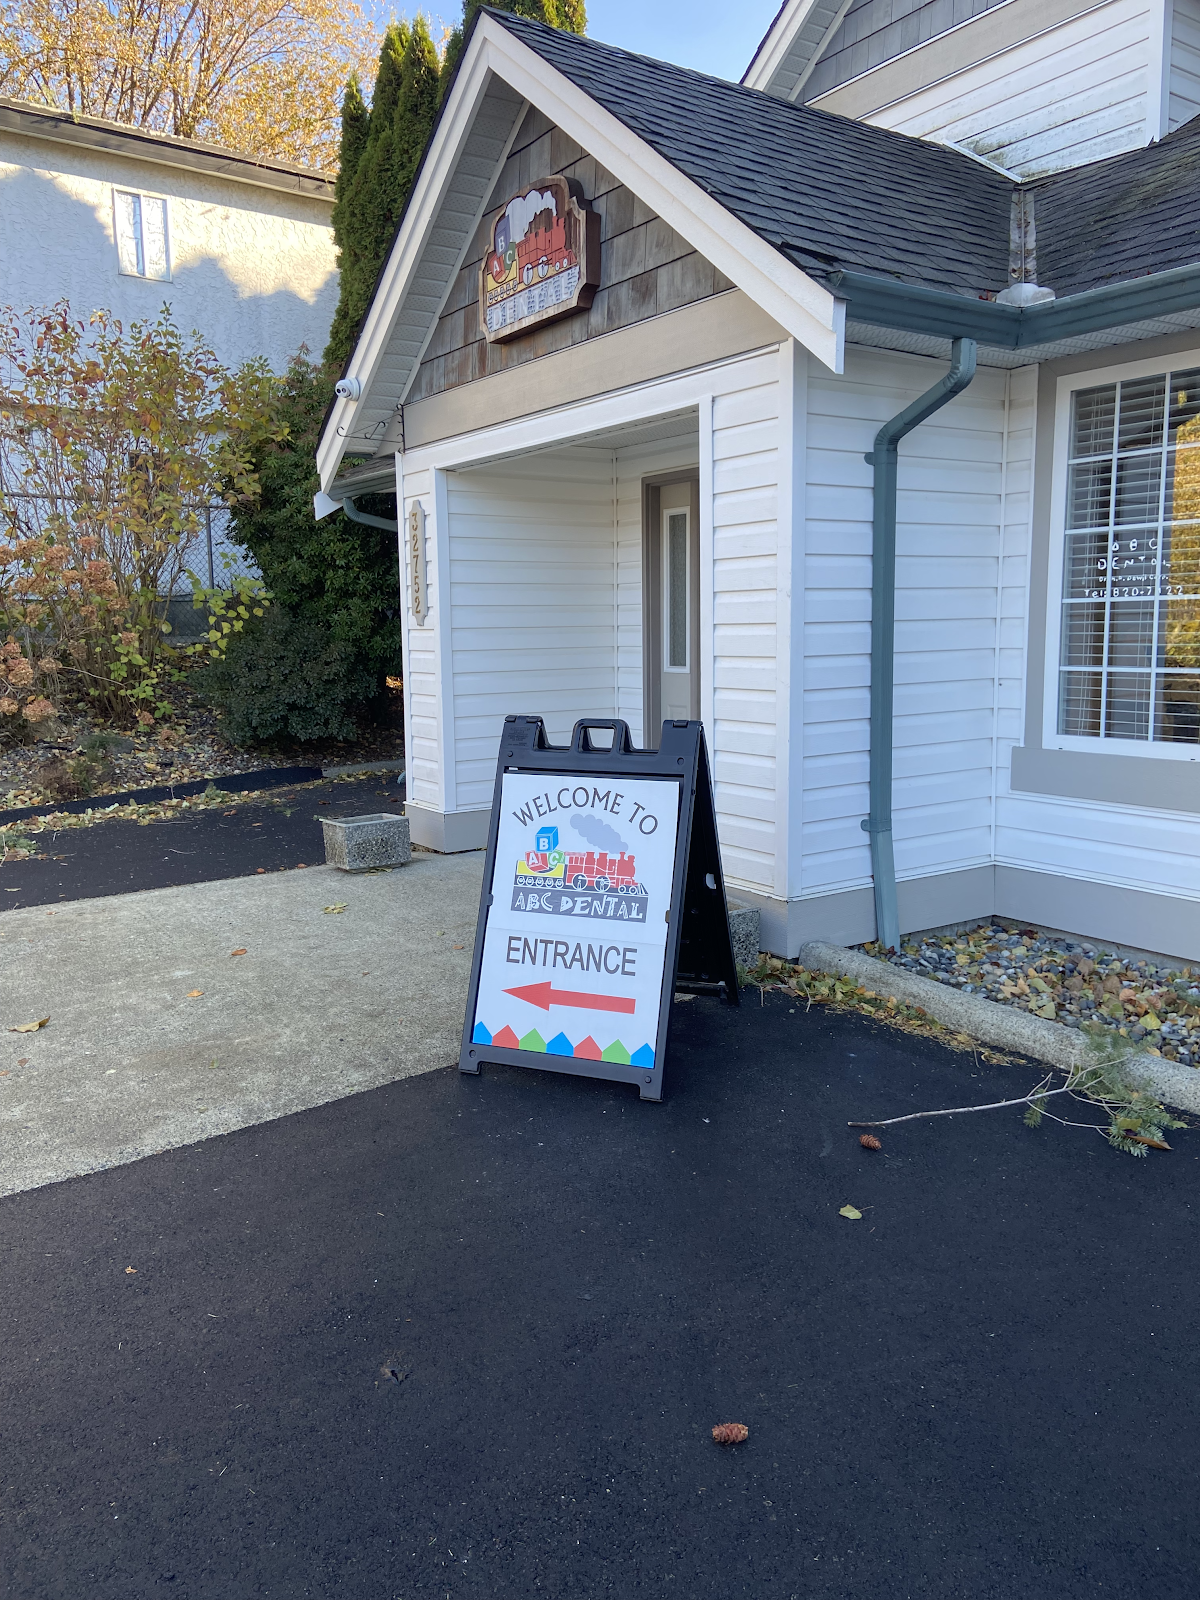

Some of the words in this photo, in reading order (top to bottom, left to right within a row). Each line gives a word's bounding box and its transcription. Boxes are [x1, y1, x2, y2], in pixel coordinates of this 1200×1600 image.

[493, 276, 569, 328] DENTAL
[512, 786, 625, 828] WELCOME
[628, 801, 659, 836] TO
[514, 891, 554, 912] ABC
[560, 894, 643, 920] DENTAL
[506, 935, 638, 977] ENTRANCE
